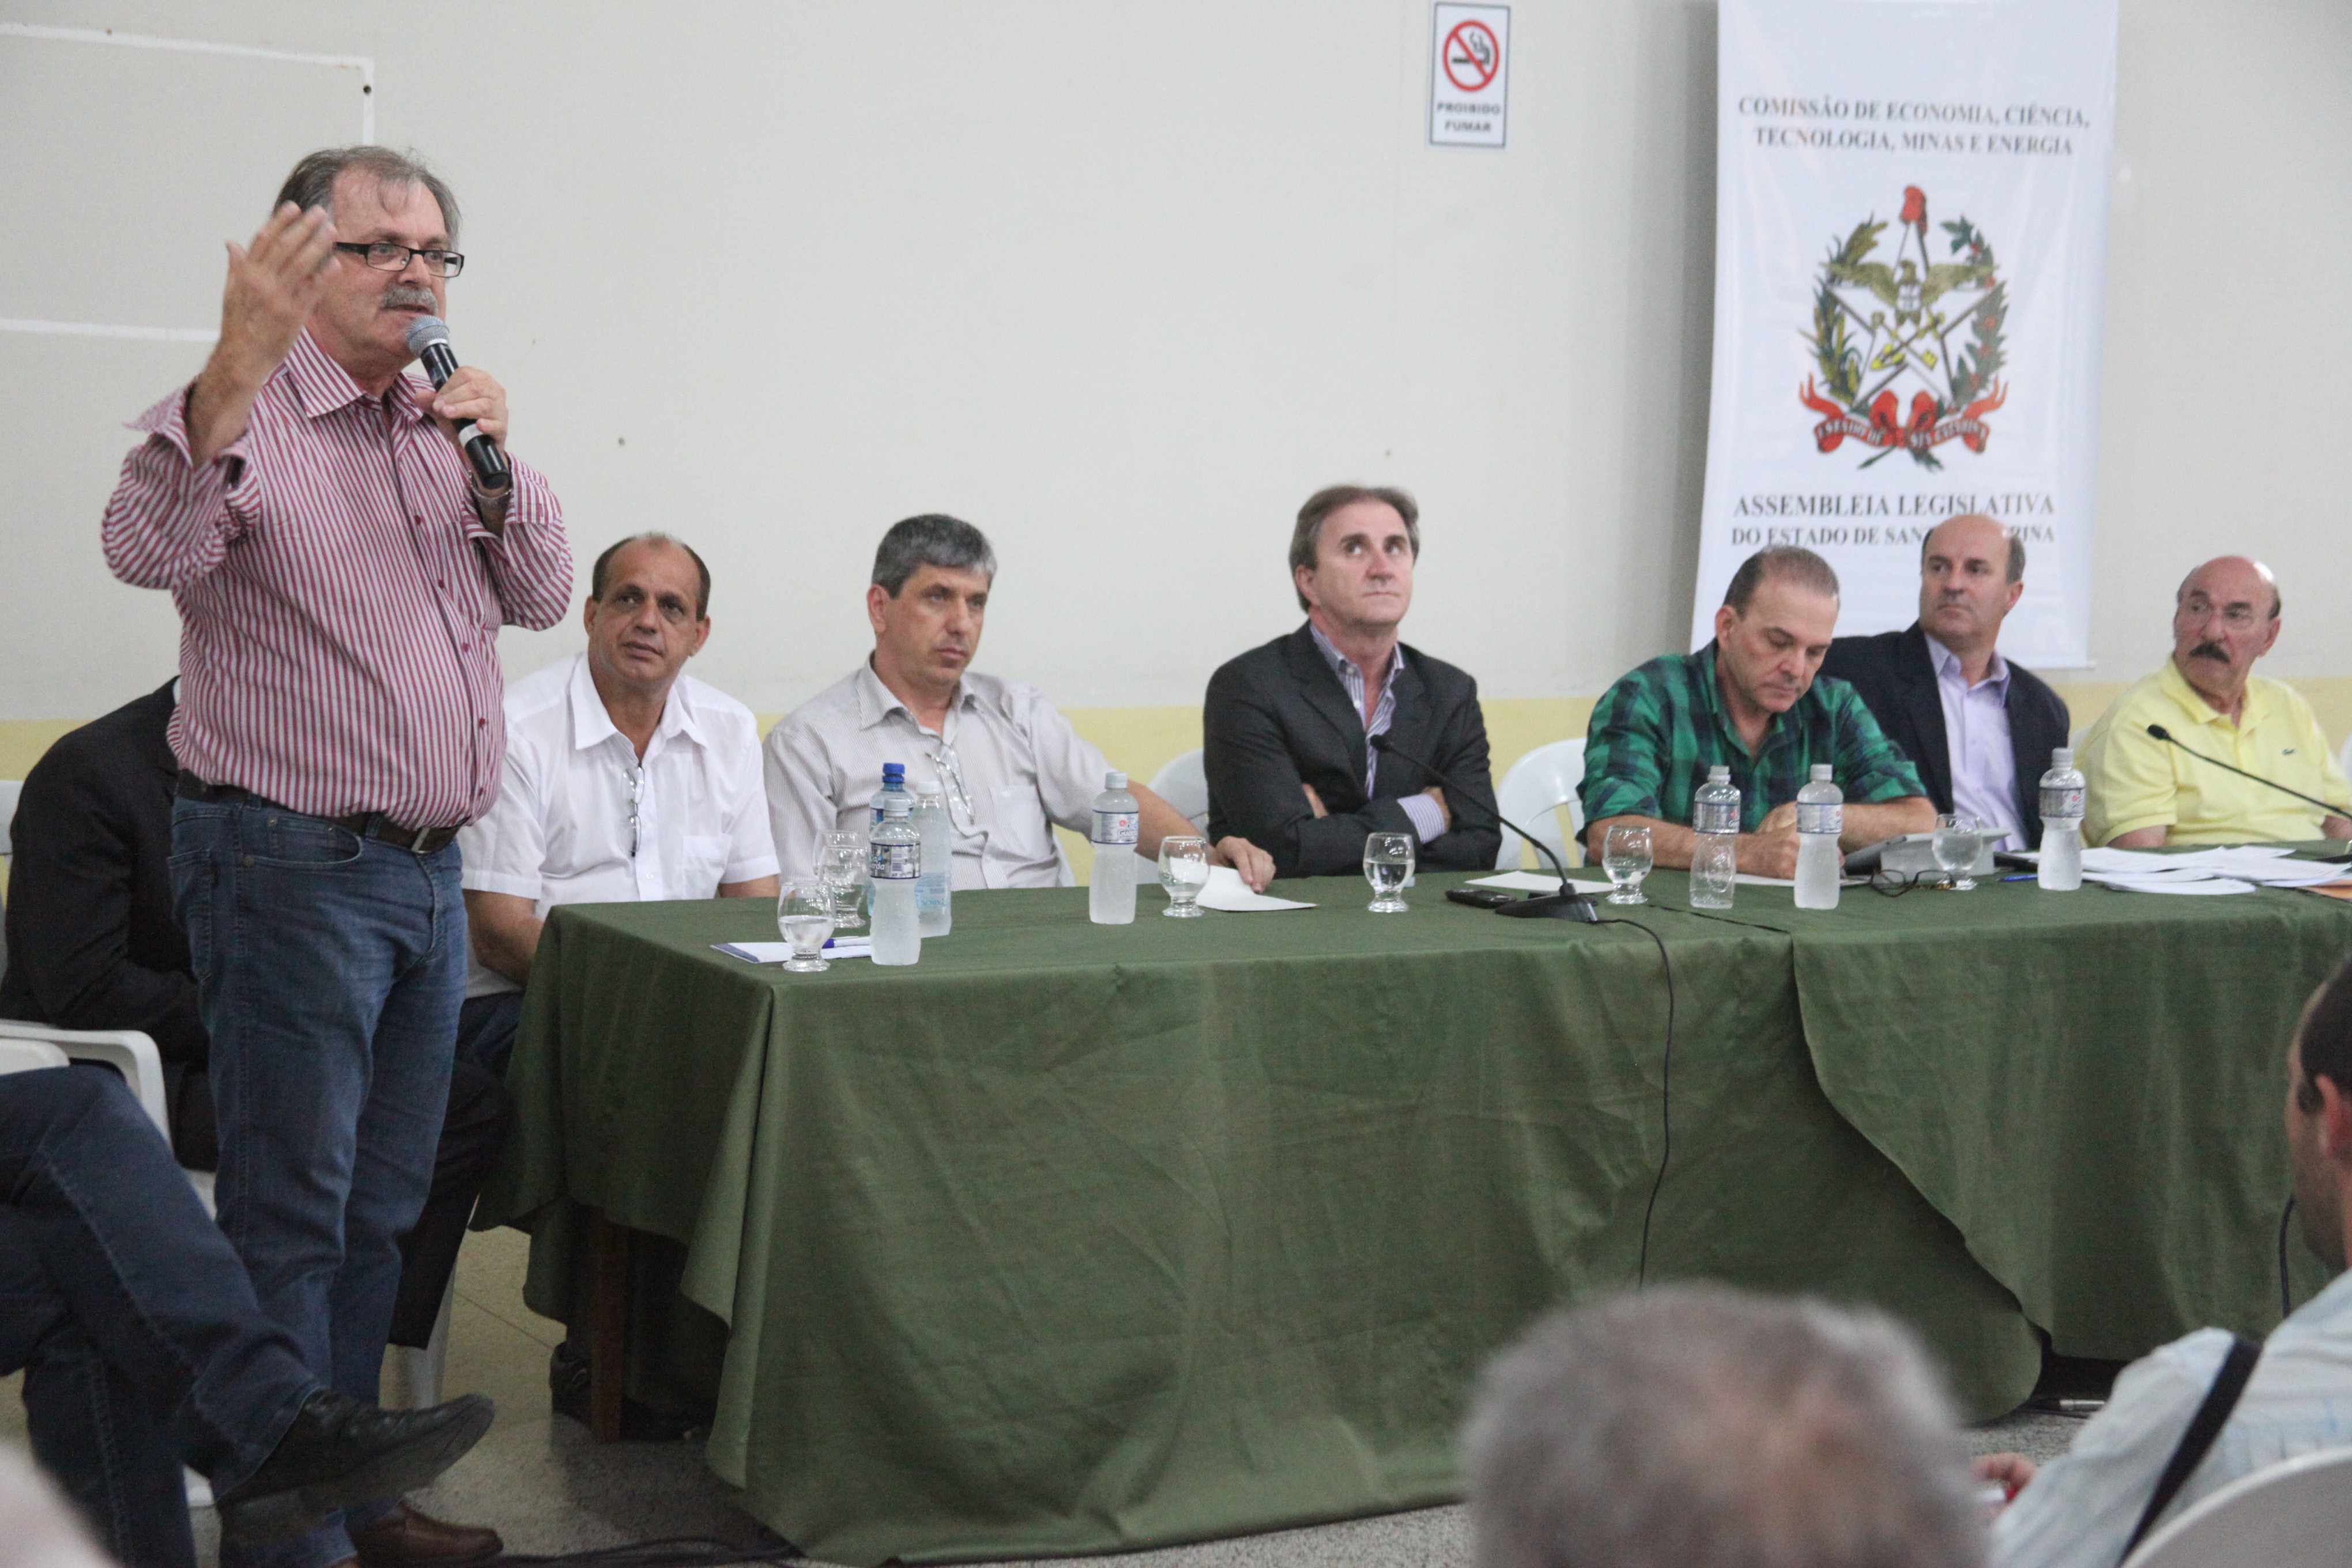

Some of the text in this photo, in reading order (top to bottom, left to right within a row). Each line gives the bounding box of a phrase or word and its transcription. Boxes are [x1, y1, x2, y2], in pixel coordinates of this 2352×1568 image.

[1437, 101, 1501, 115] PROIBIDO
[1739, 94, 2090, 131] COMISSÃO DE ECONOMIA, CIÊNCIA,
[1445, 120, 1491, 133] FUMAR
[1754, 126, 2073, 155] TECNOLOGIA, MINAS E ENERGIA
[1733, 494, 2055, 517] ASSEMBLEIA LEGISLATIVA
[1732, 527, 1761, 545] DO
[1767, 527, 1848, 546] ESTADO
[1853, 527, 1879, 545] DE
